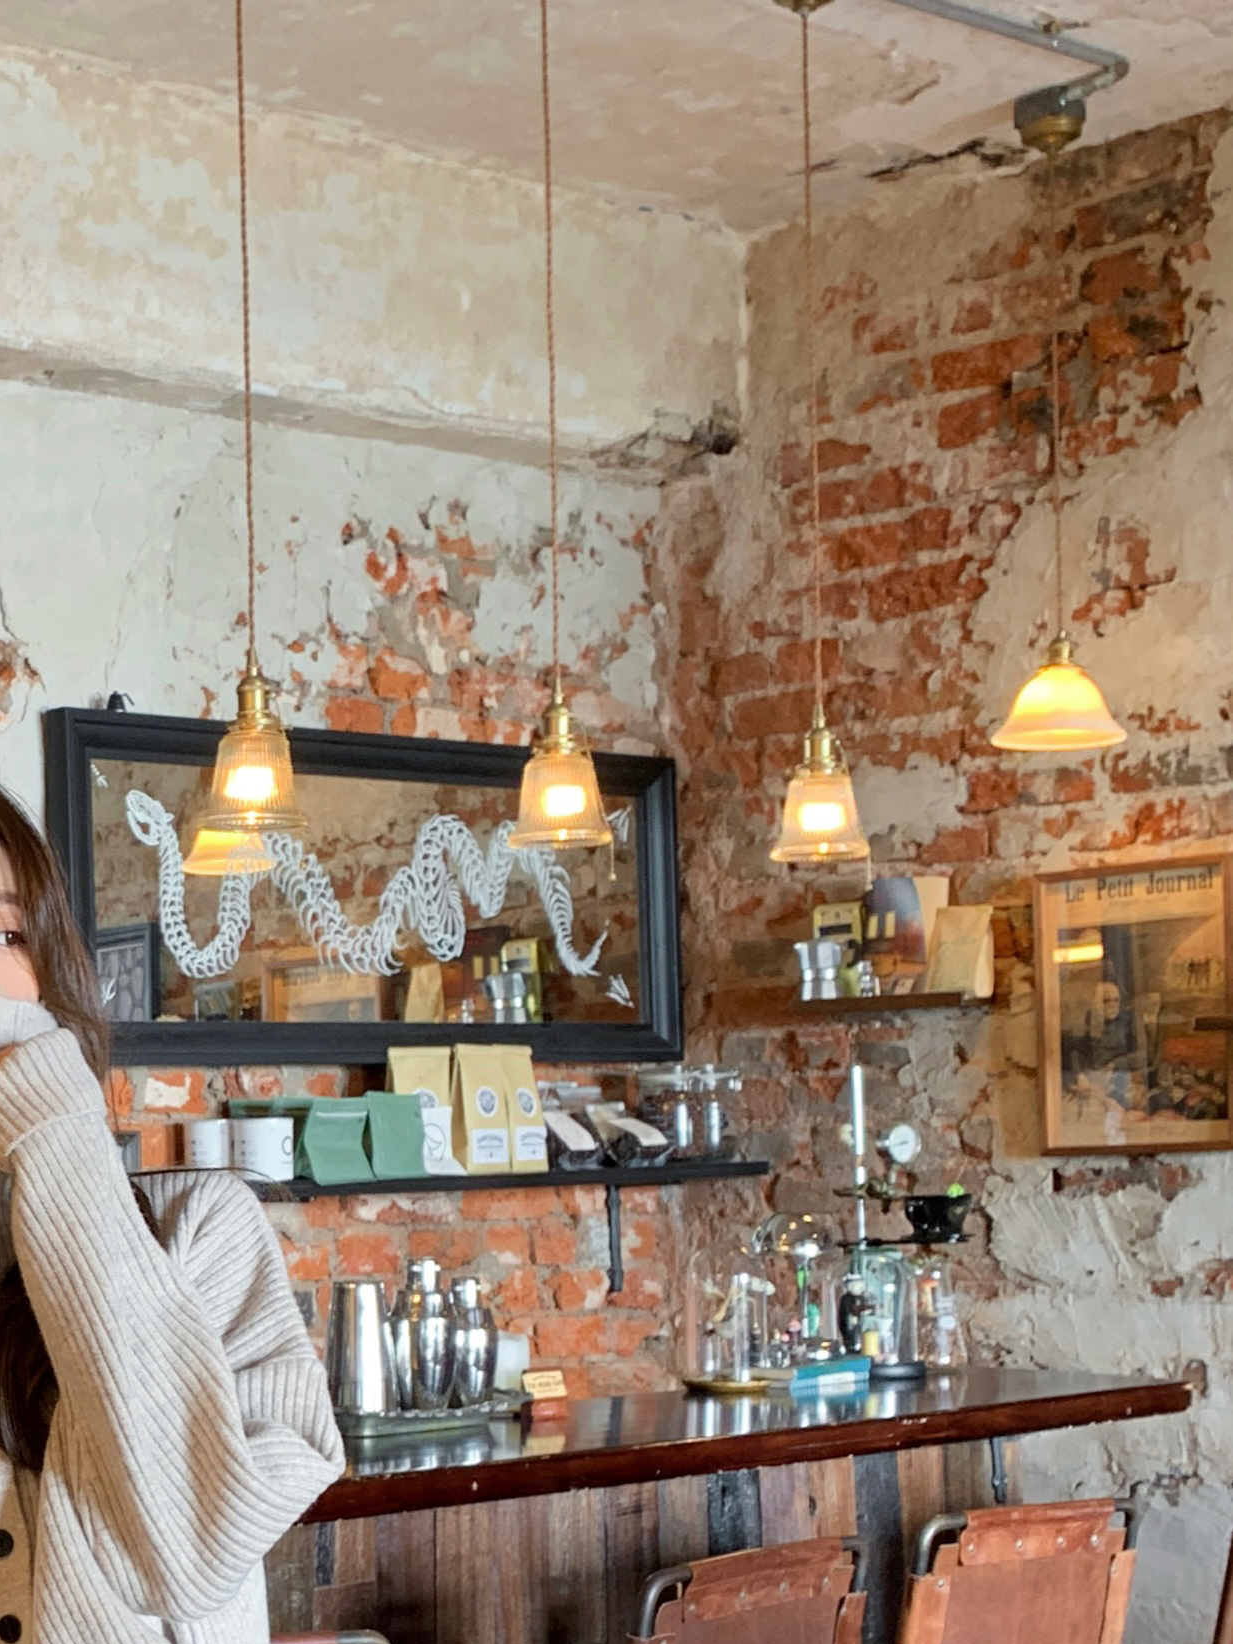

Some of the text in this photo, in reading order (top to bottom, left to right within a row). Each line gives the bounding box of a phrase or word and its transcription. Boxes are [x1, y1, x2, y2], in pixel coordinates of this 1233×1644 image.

[1065, 865, 1214, 903] Le Petit Journal
